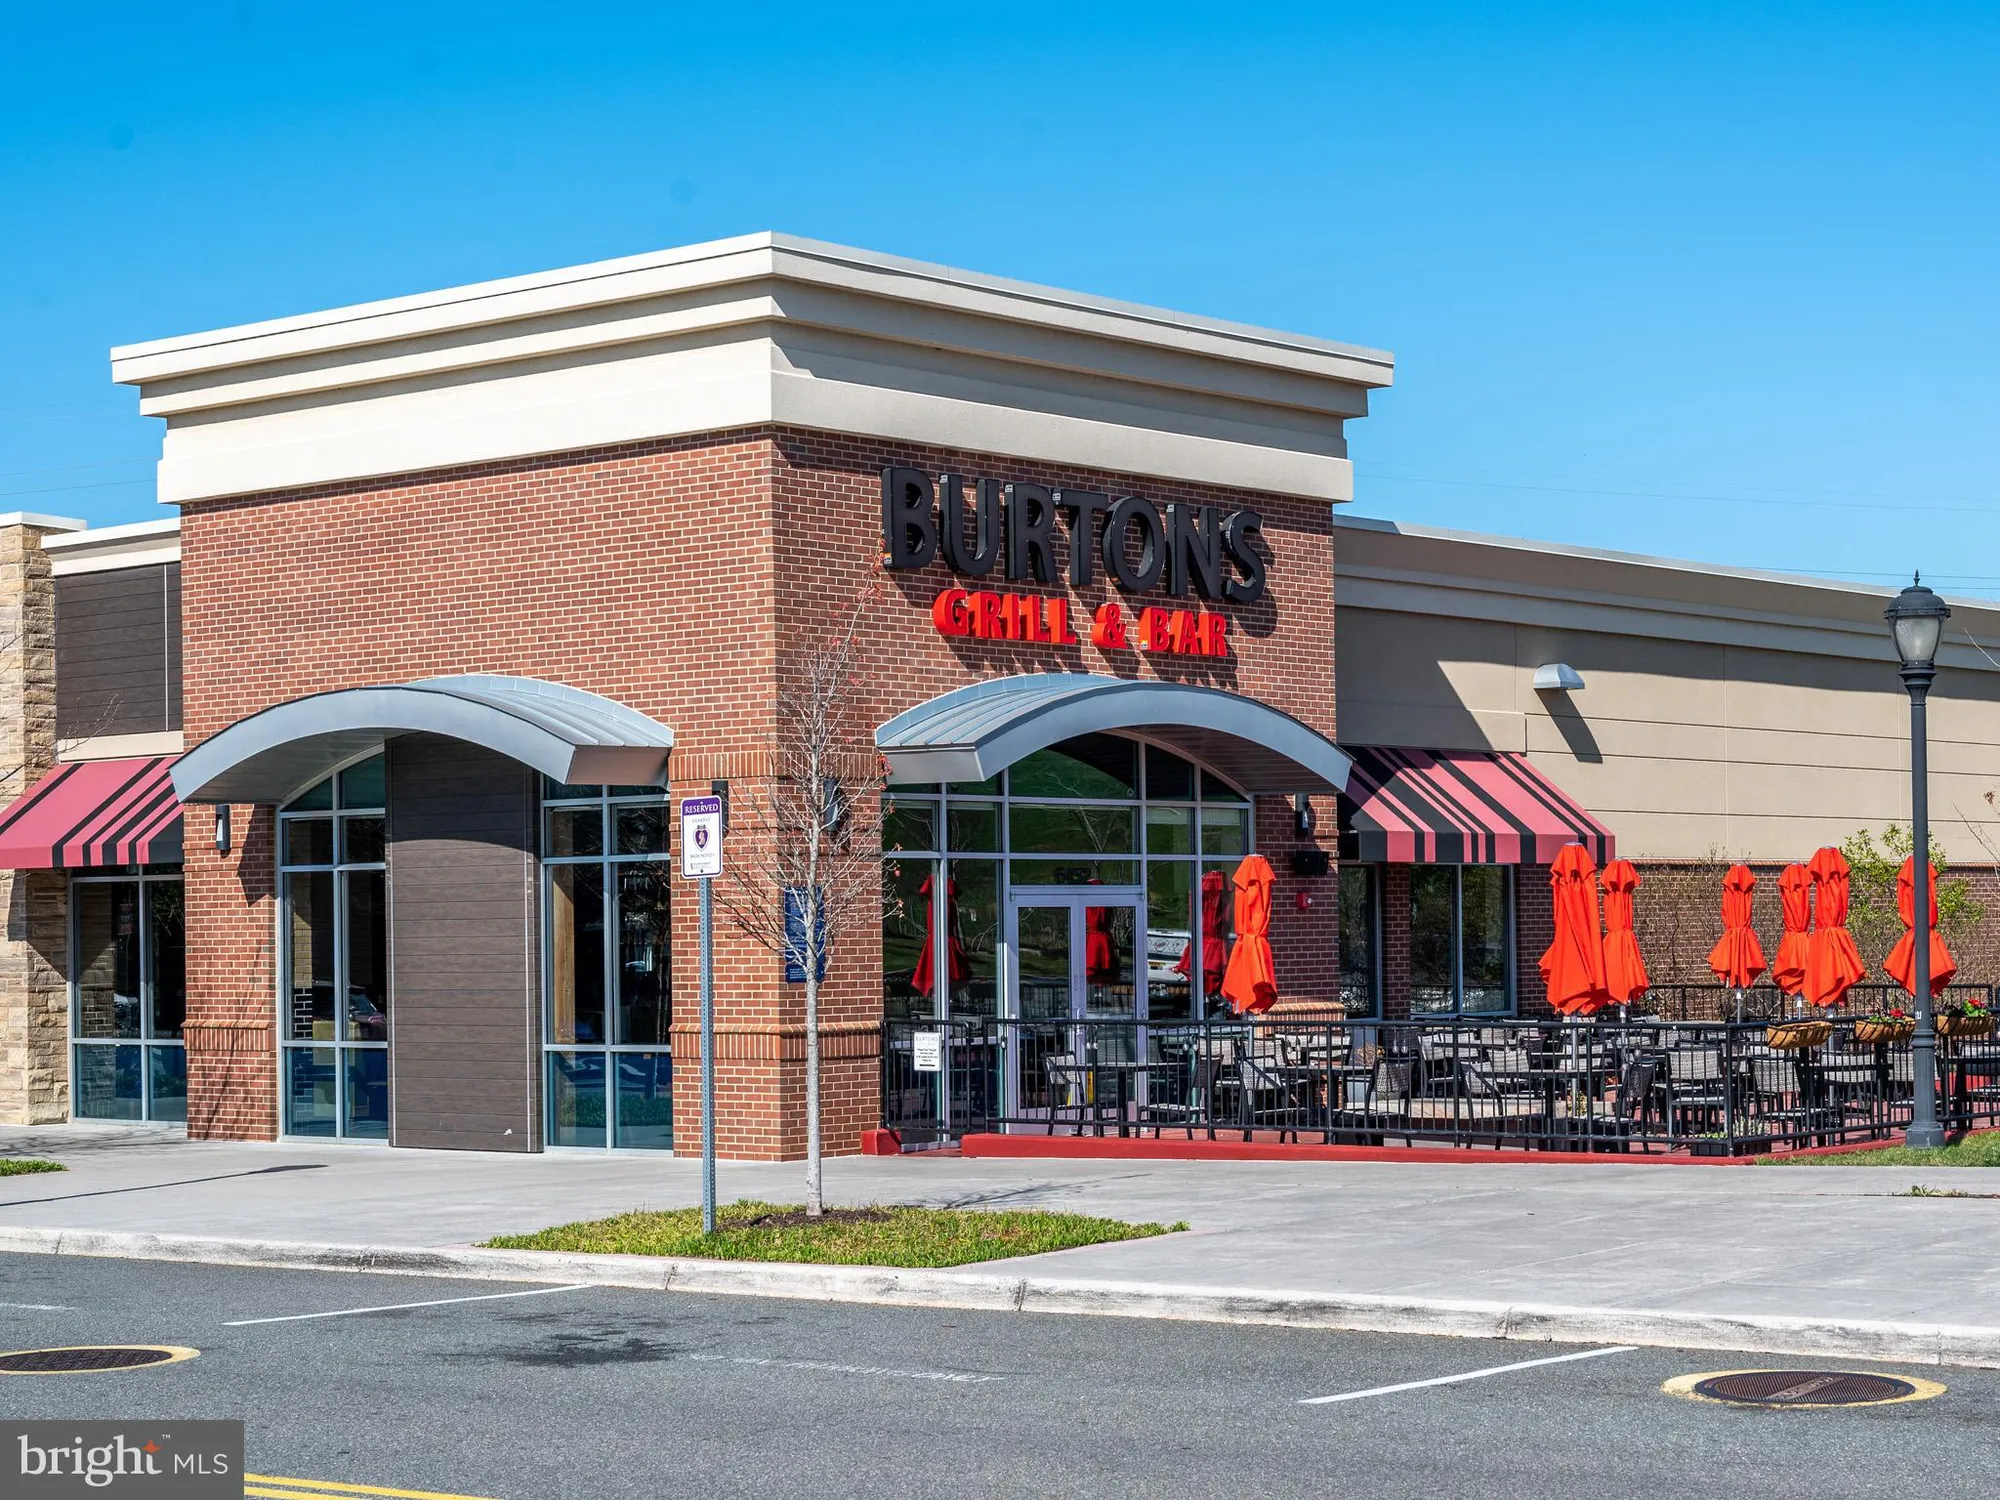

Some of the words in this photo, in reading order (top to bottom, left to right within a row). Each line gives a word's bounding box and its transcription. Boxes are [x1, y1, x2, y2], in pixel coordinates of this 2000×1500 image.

[881, 467, 1266, 602] BURTONS
[932, 588, 1077, 645] GRILL
[1091, 602, 1127, 649] &
[1139, 606, 1227, 656] BAR
[685, 804, 719, 814] RESERVED
